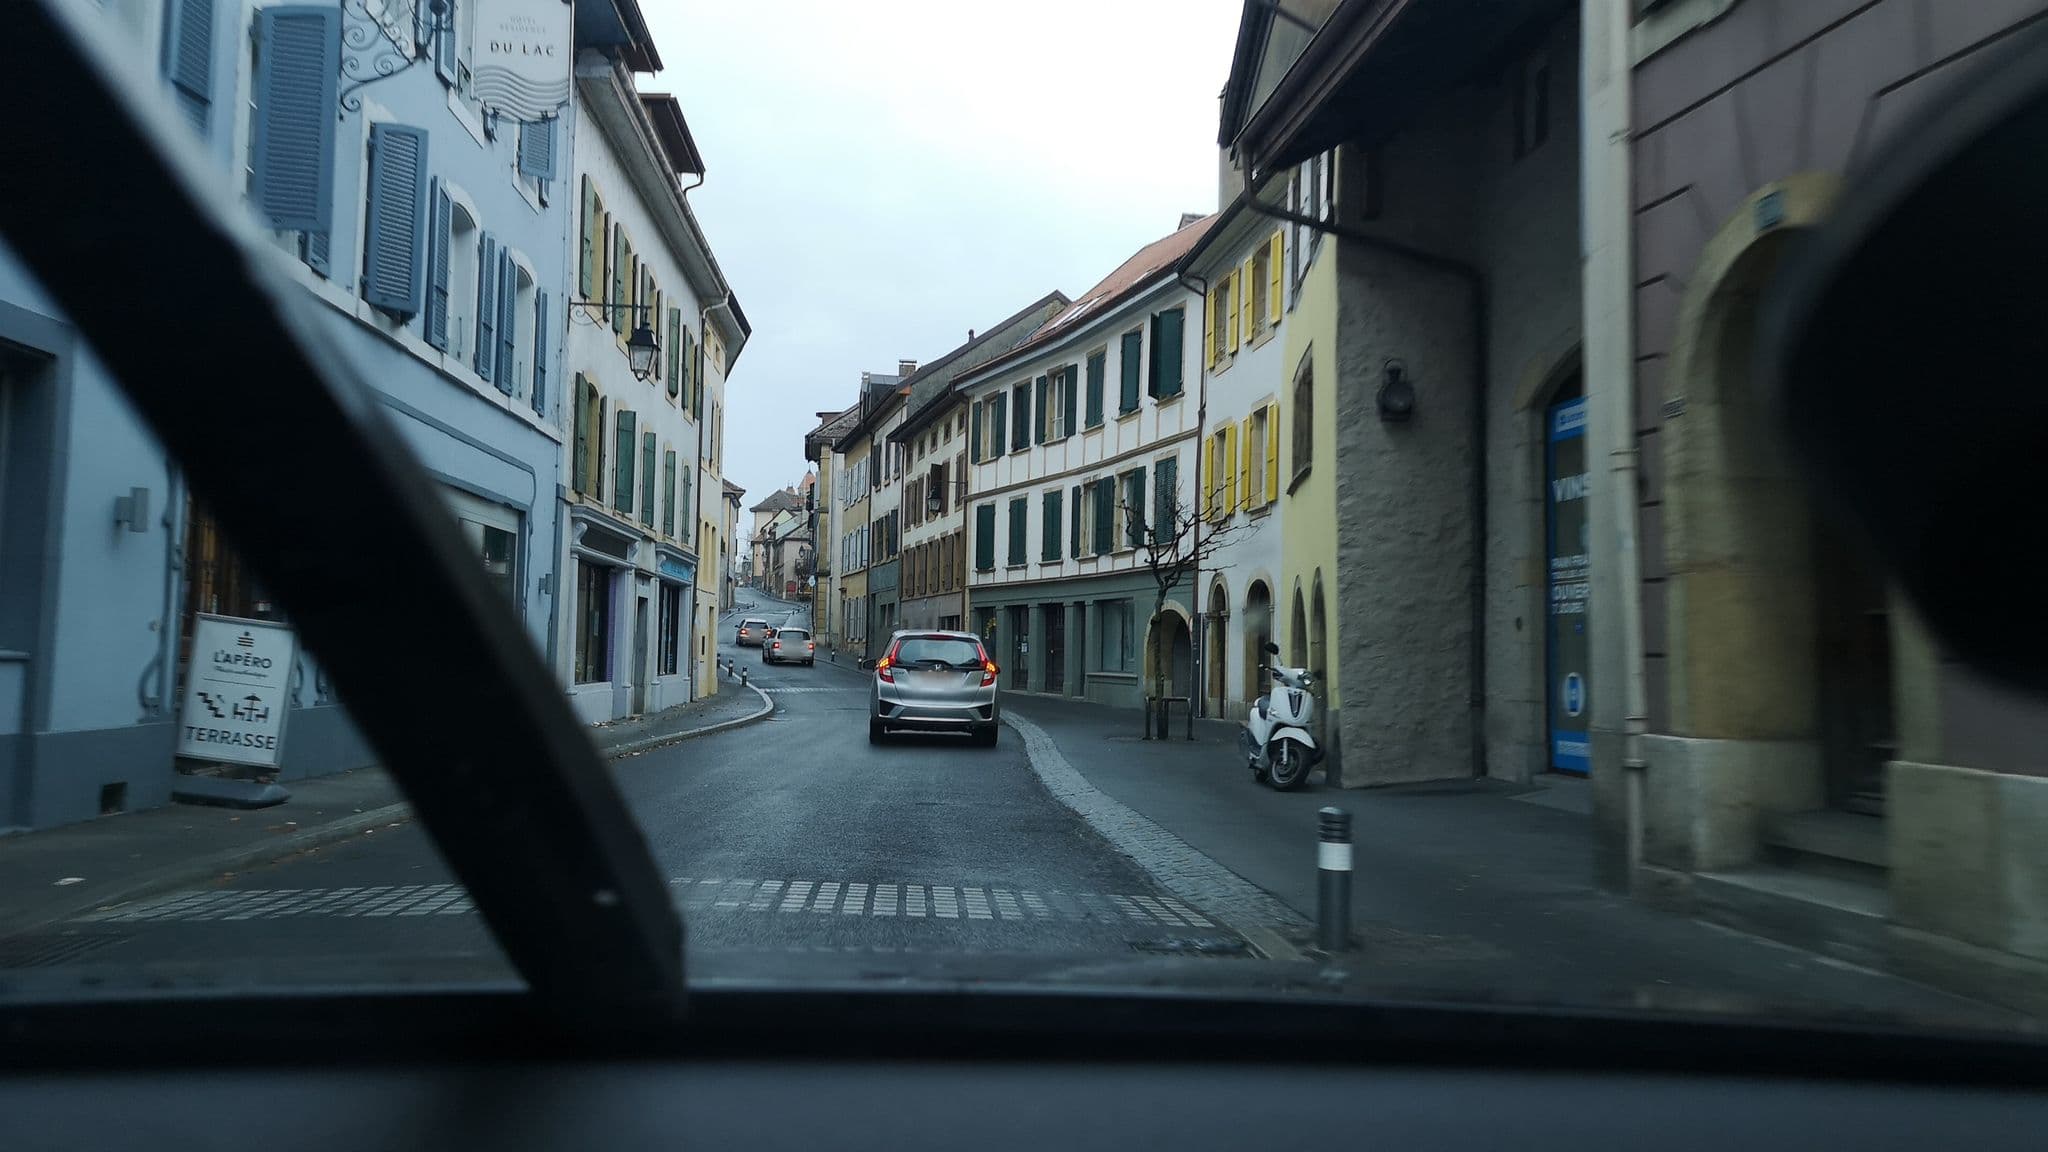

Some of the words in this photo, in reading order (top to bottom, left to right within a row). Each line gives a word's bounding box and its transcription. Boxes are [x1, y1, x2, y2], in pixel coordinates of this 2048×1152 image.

[490, 40, 512, 54] DU
[522, 42, 555, 57] LAC
[184, 726, 277, 750] TERRASSE
